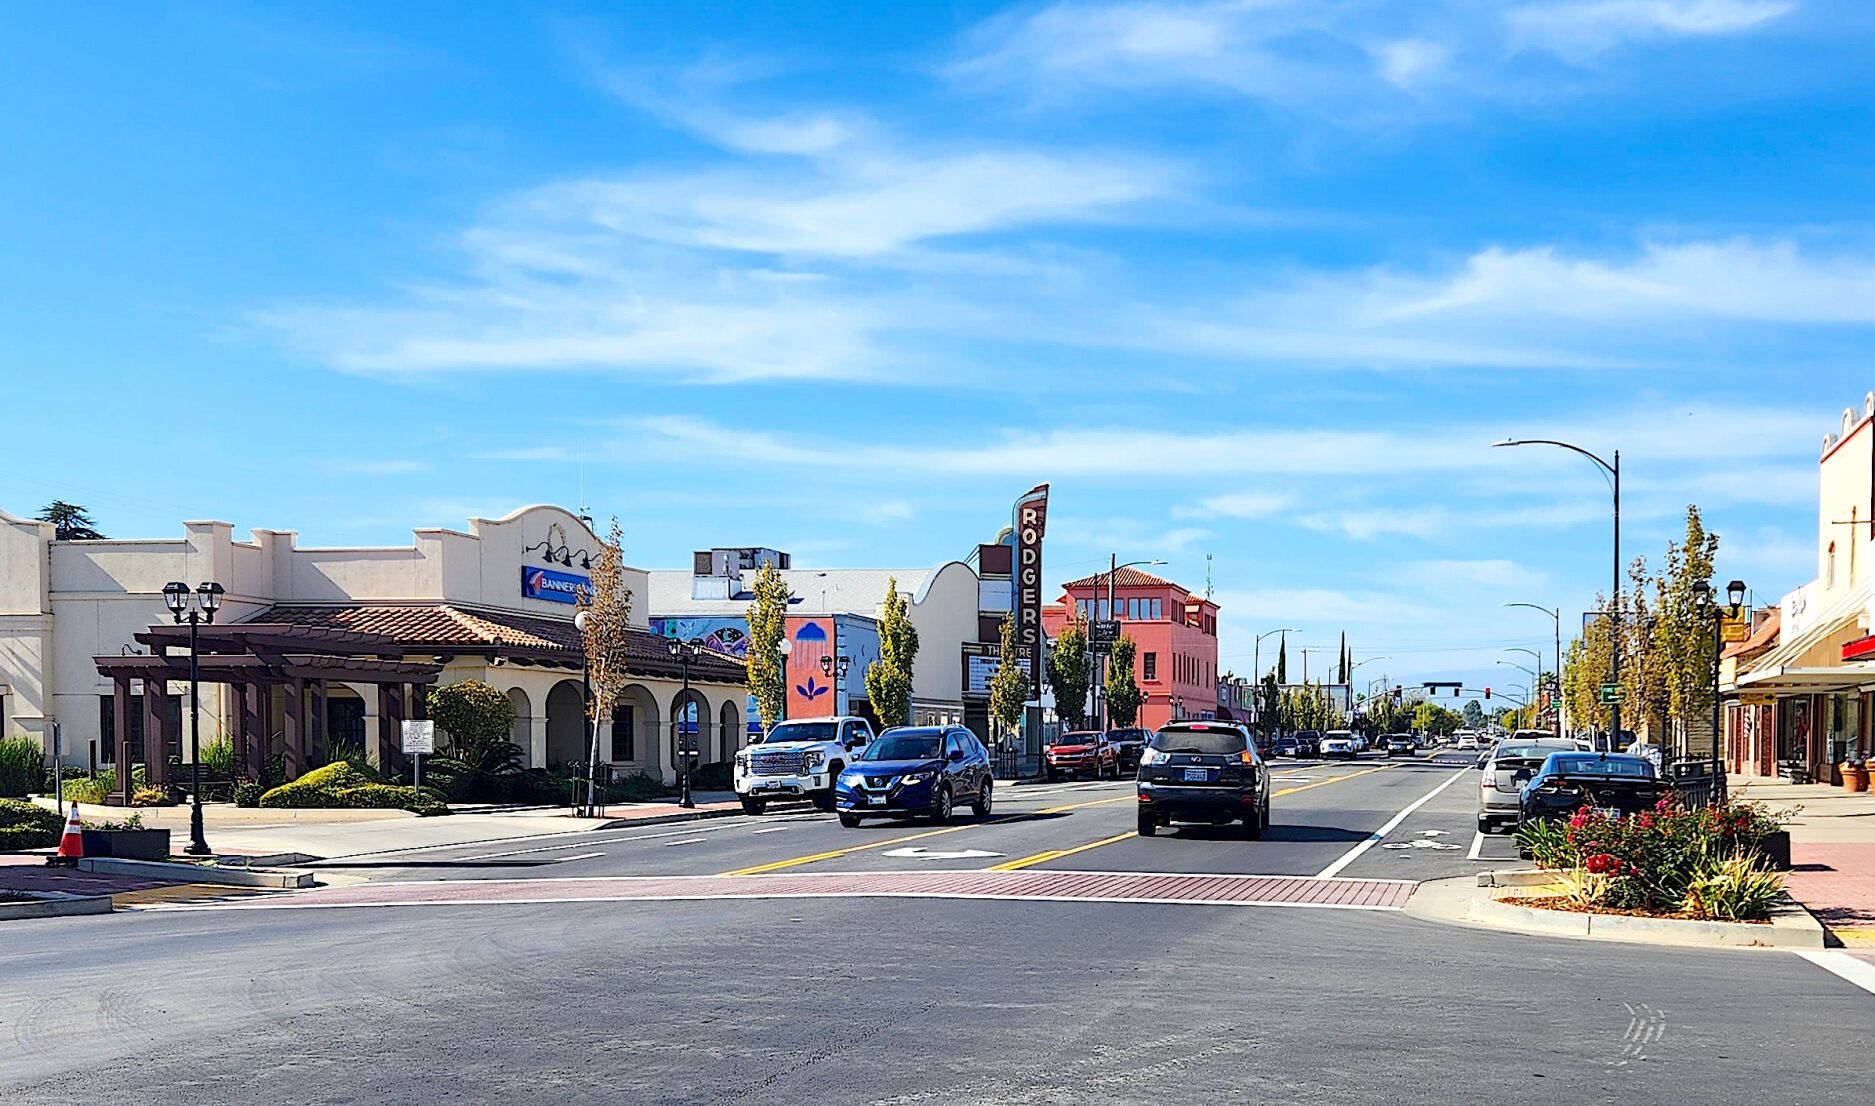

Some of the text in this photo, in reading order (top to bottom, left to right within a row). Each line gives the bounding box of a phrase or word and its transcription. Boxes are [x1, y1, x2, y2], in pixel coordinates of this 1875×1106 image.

[1022, 508, 1037, 644] RODGERS
[541, 578, 575, 592] BANNER
[987, 646, 1032, 657] THRE
